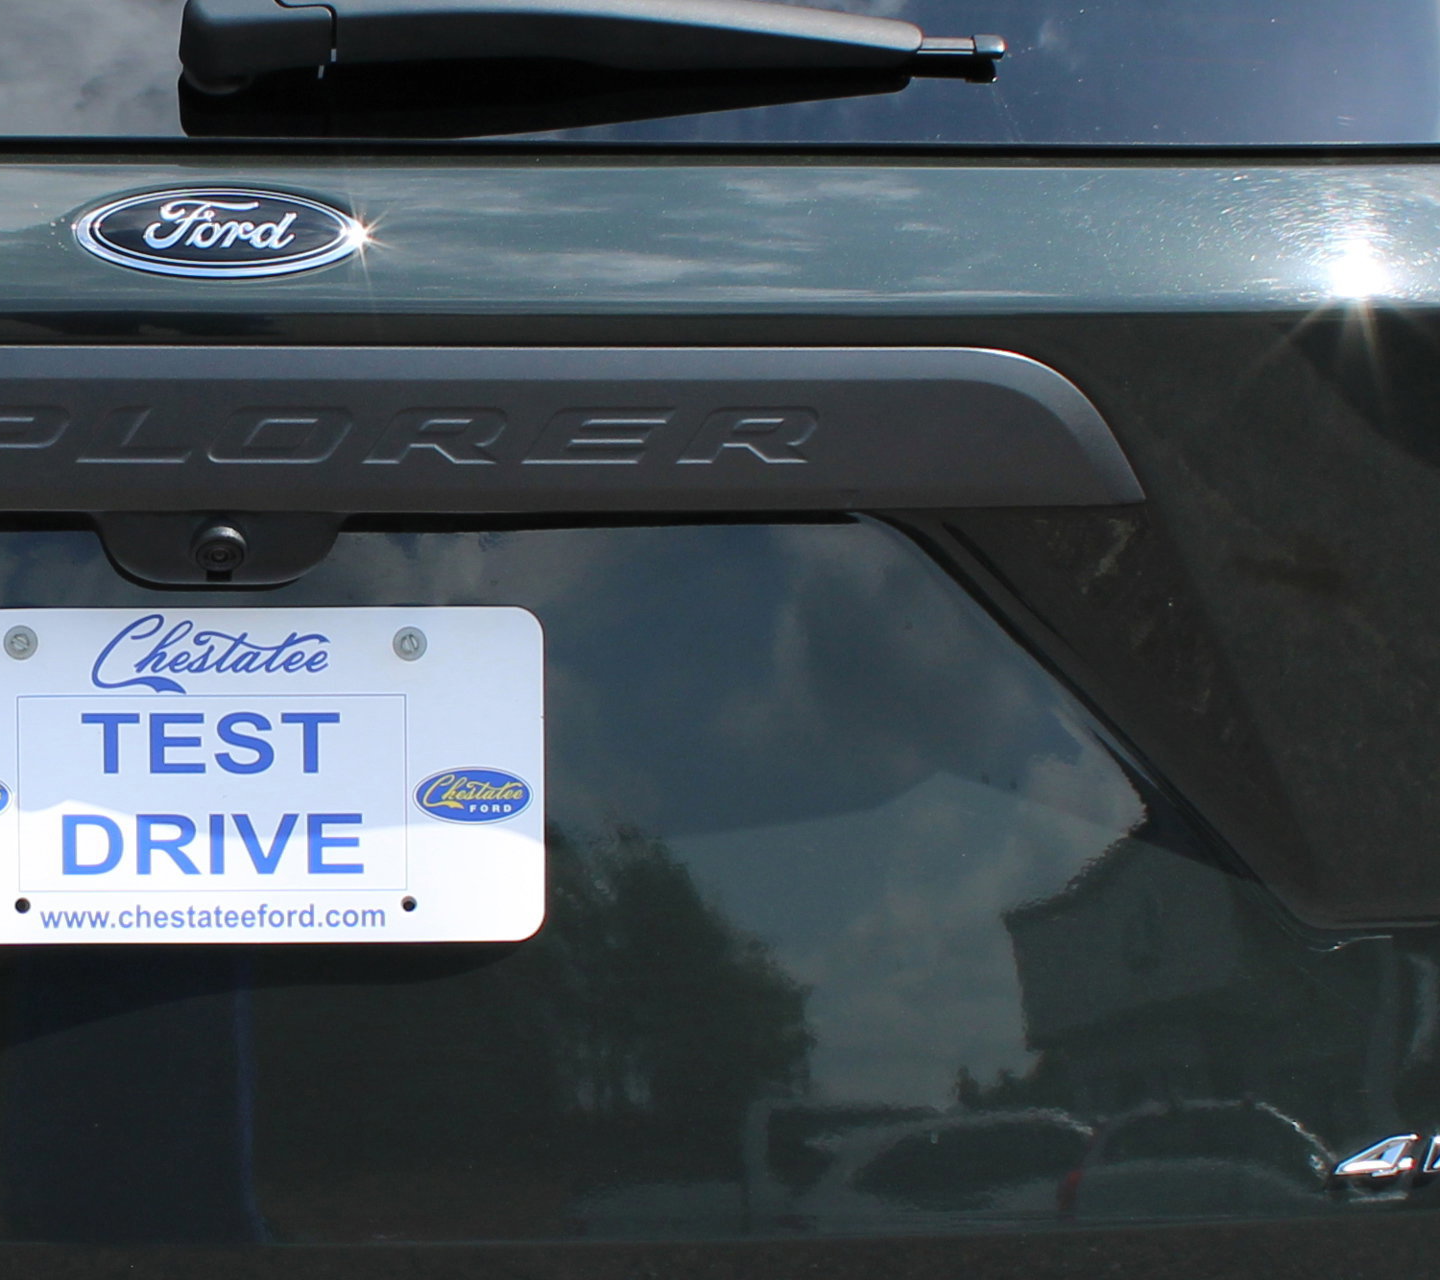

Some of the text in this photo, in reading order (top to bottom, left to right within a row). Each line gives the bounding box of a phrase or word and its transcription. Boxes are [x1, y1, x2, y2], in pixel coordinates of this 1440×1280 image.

[144, 199, 298, 250] Ford
[90, 613, 331, 694] Chestatee
[80, 712, 341, 775] TEST
[422, 773, 524, 810] Chestatee
[469, 803, 513, 813] FORD
[60, 813, 365, 876] DRIVE
[40, 903, 387, 929] www.chestateeford.com
